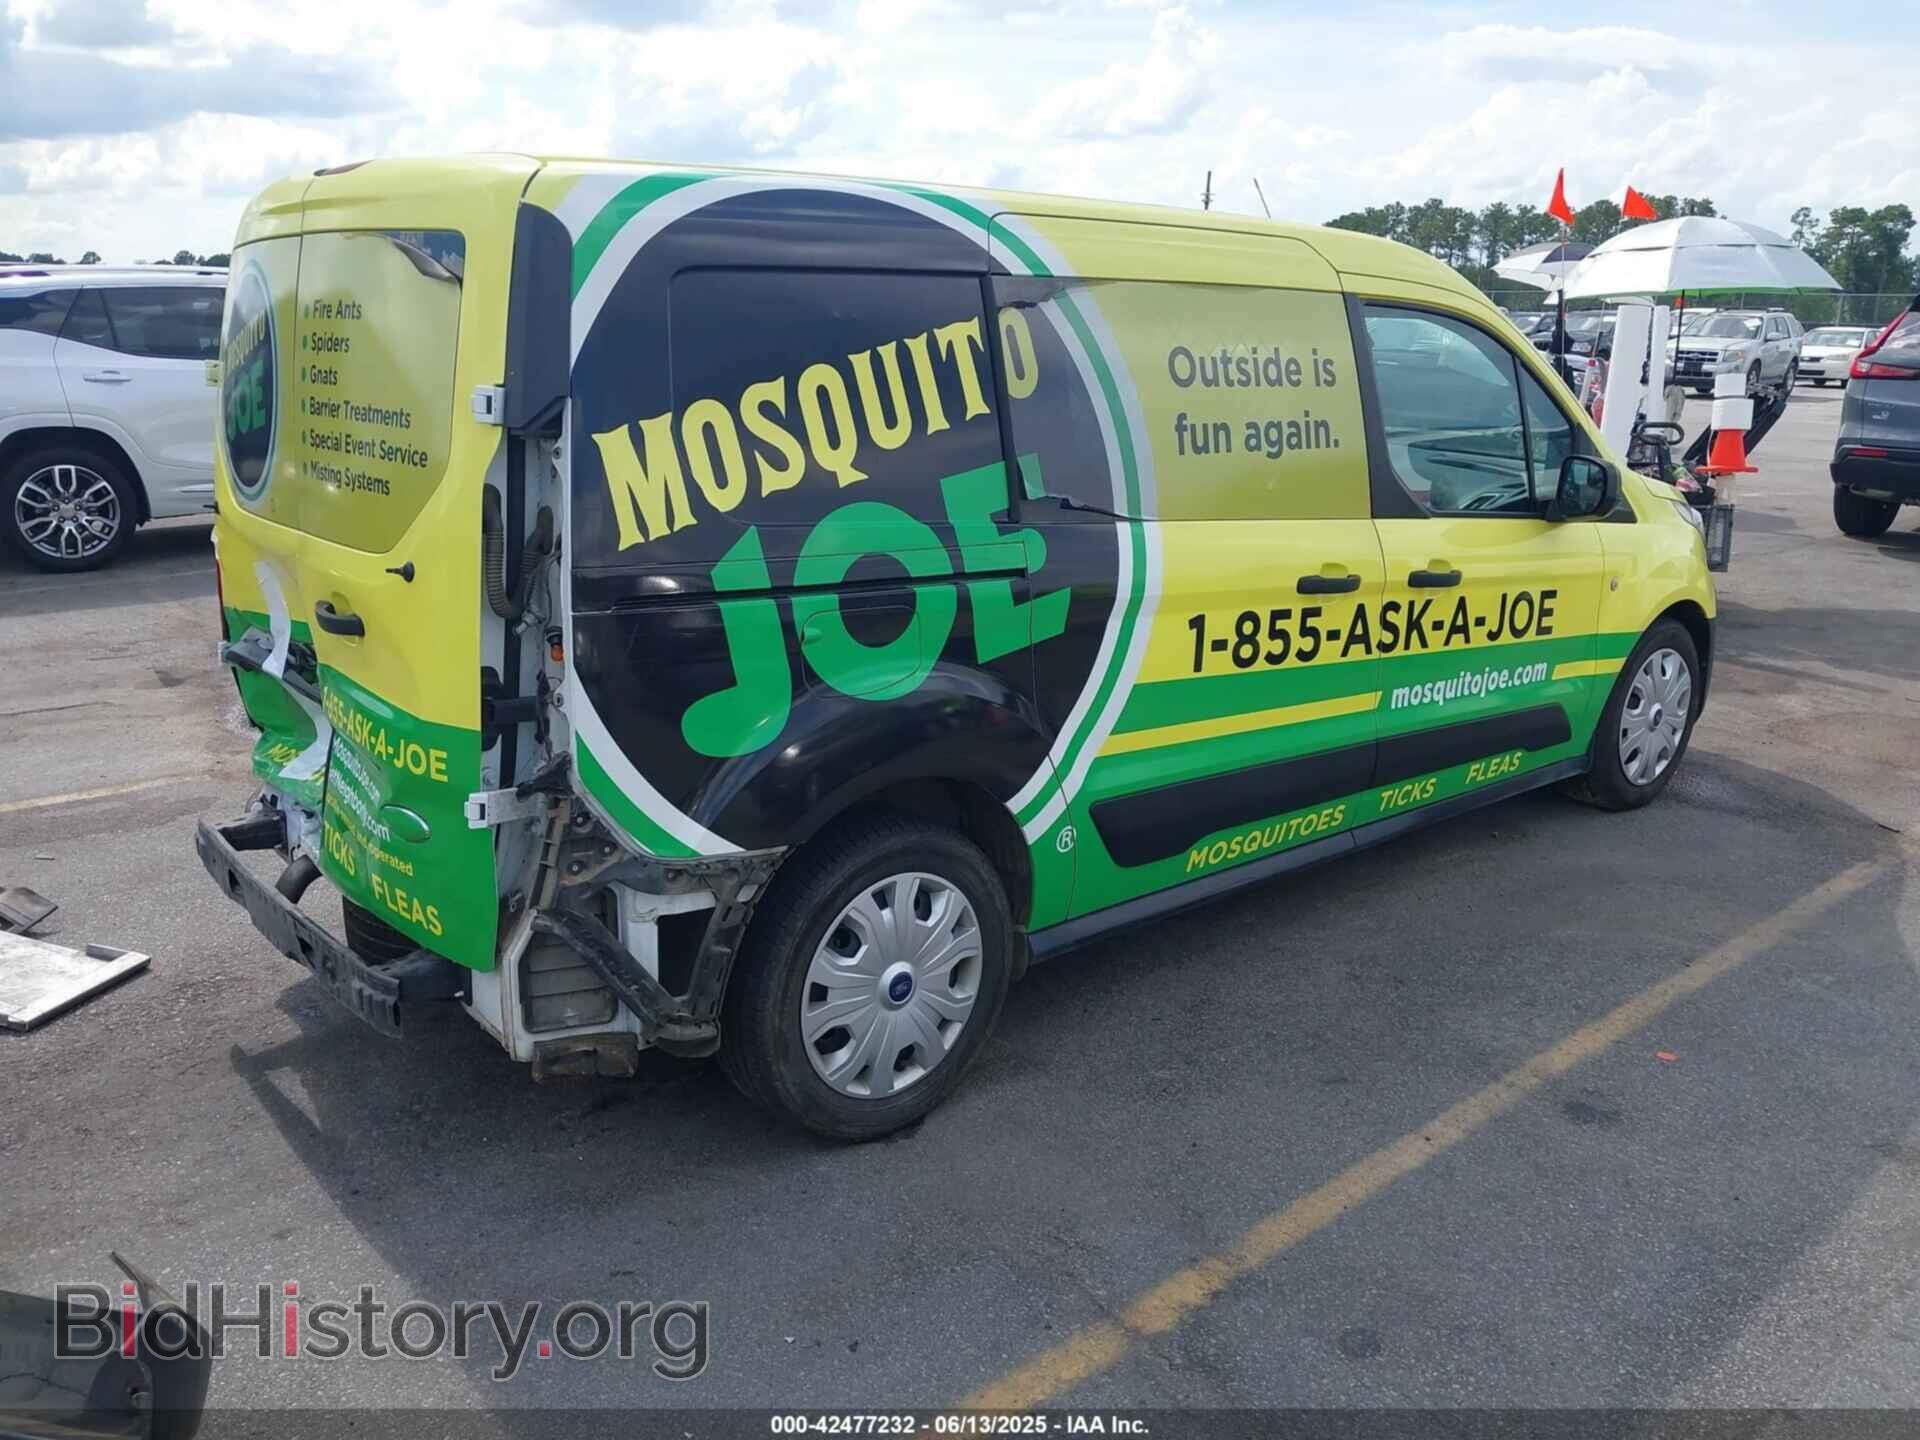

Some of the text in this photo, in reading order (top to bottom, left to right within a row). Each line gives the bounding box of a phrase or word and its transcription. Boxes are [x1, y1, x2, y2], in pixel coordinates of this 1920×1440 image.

[313, 299, 362, 320] Fire Ants
[311, 332, 350, 355] Spiders
[309, 364, 338, 386] Gnats
[1168, 346, 1337, 388] Outside is
[309, 396, 411, 429] Barrier Treatments
[592, 307, 1039, 552] MOSQUITO
[1175, 410, 1339, 459] fun again.
[310, 428, 428, 468] Special Event Service
[311, 460, 390, 496] Misting Systems
[681, 453, 1072, 758] JOE
[1187, 589, 1558, 673] 1-855-ASK-A-JOE
[1390, 661, 1548, 709] mosquitojoe.com
[1186, 751, 1523, 872] MOSQUITOES TICKS FLEAS
[324, 820, 356, 877] TICKS
[371, 873, 444, 936] FLEAS
